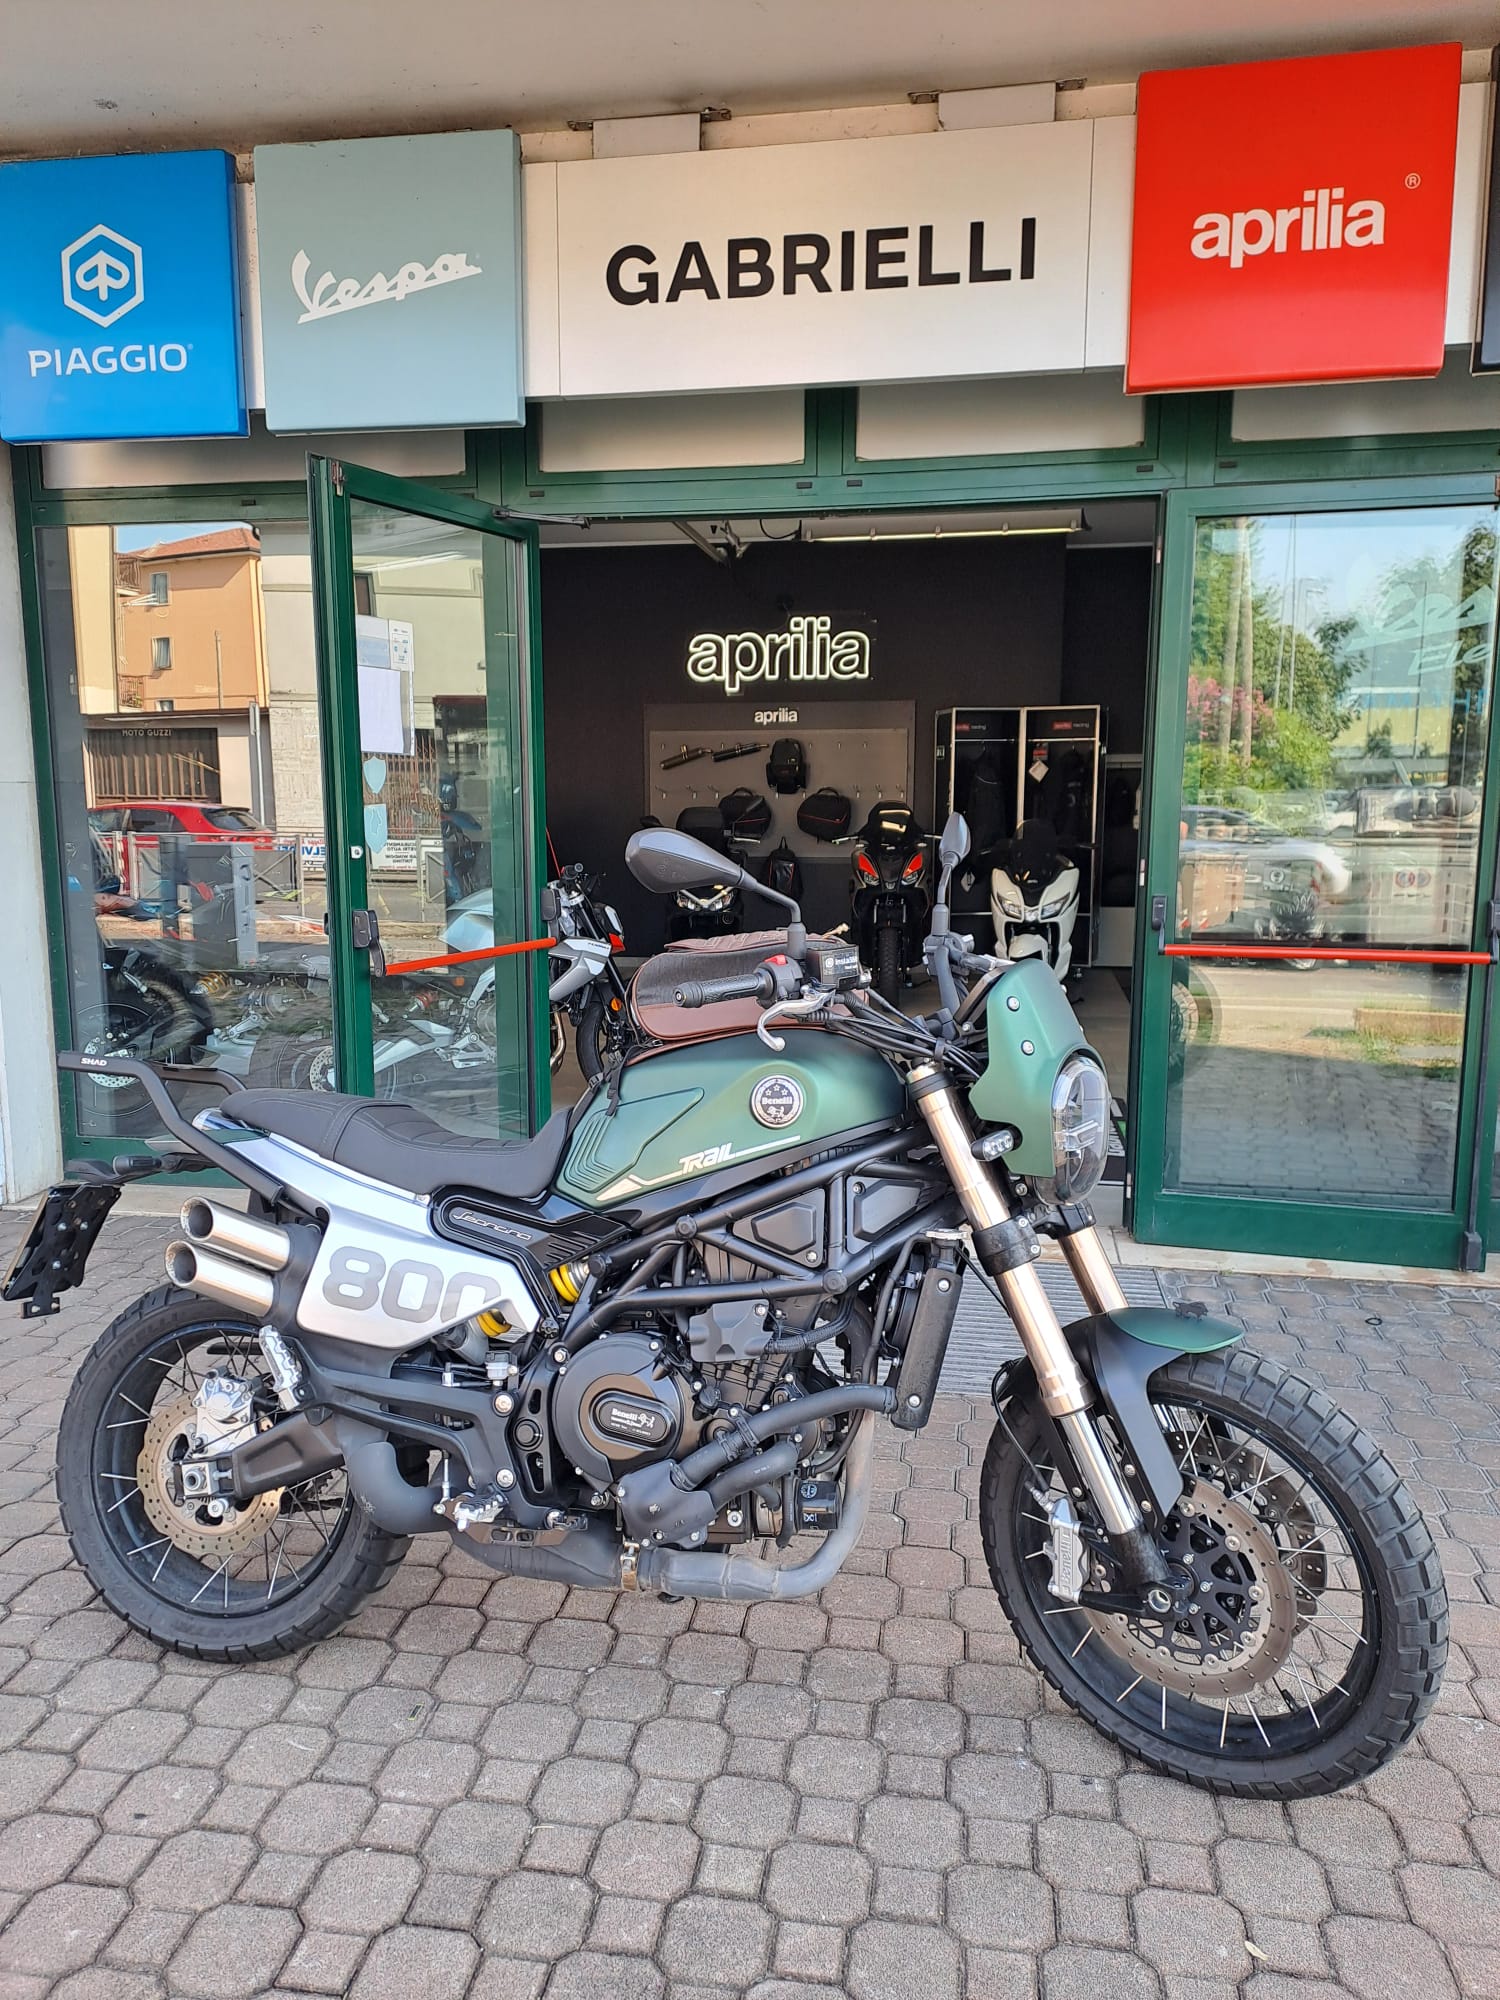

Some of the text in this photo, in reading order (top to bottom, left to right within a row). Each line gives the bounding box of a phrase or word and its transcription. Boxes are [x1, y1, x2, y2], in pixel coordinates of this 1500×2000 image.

[1190, 187, 1386, 269] aprilia
[606, 217, 1036, 307] GABRIELLI
[290, 248, 483, 325] Vespa
[27, 343, 188, 378] PIAGGIO
[687, 616, 870, 695] aprilia
[753, 707, 798, 725] aprilia
[122, 729, 172, 737] MOTO GUZZI
[80, 1057, 108, 1067] SHAD
[761, 1096, 793, 1105] Benelli
[453, 1211, 532, 1241] Leoncino
[611, 1407, 639, 1421] Benelli
